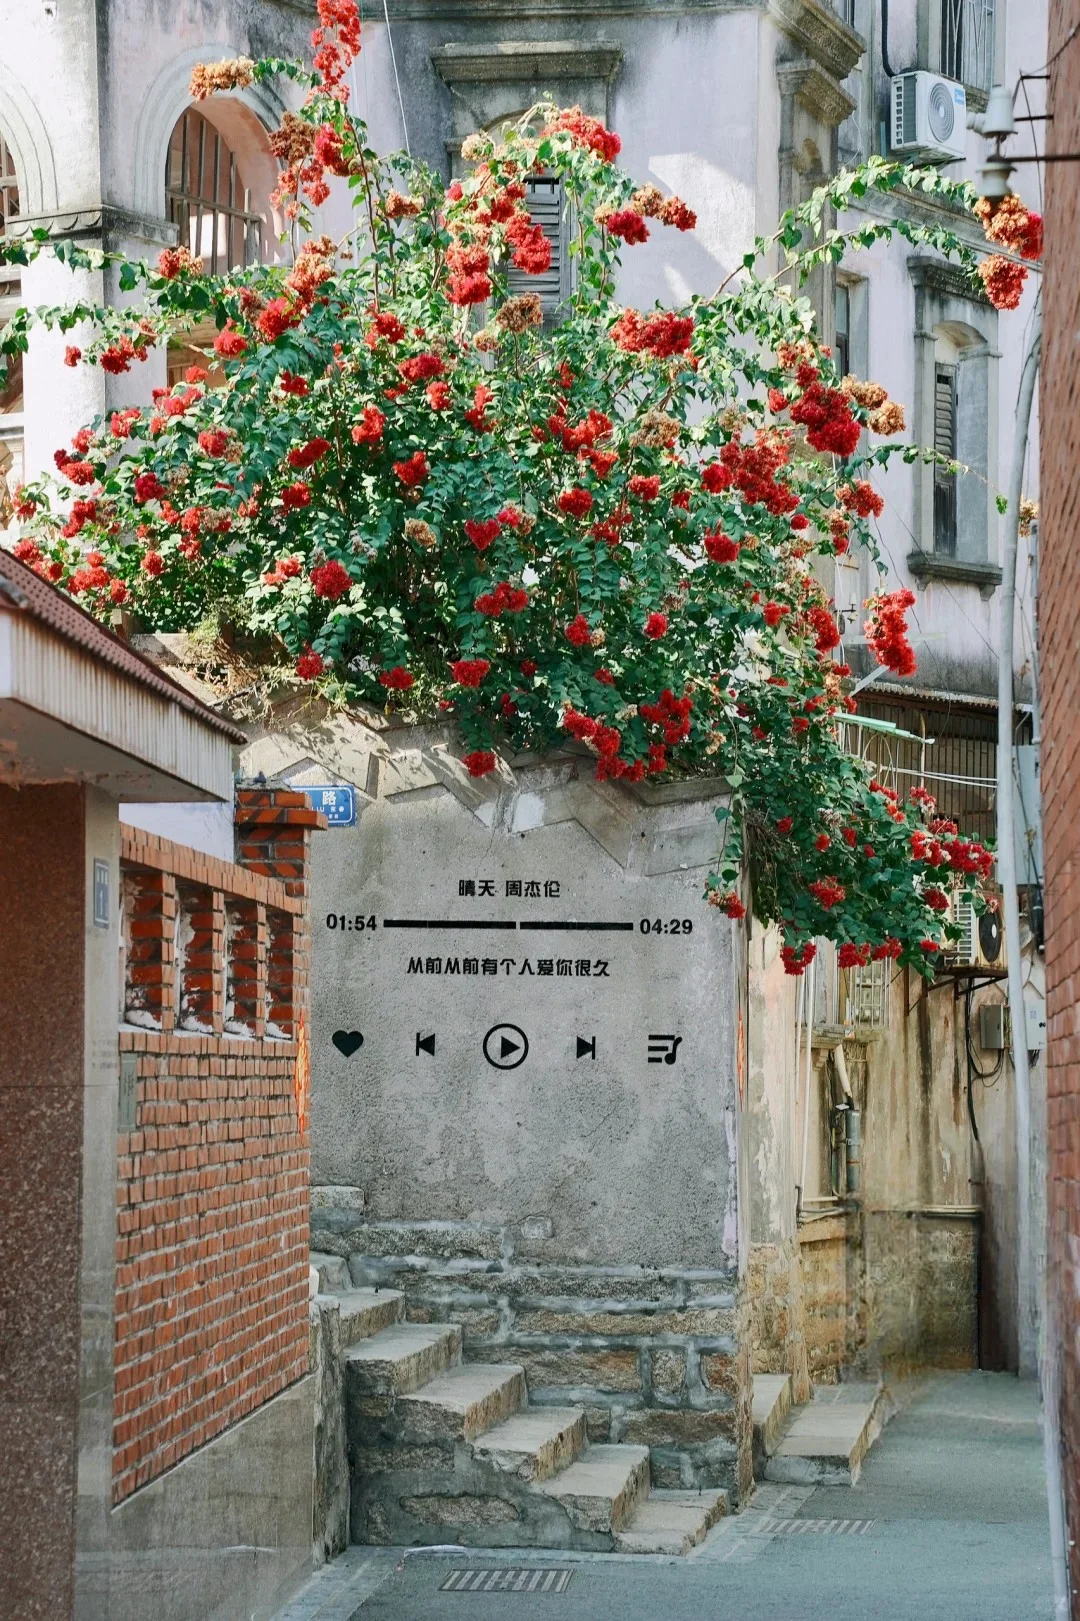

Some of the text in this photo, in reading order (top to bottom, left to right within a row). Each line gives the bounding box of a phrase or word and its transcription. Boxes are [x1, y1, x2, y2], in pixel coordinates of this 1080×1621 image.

[322, 790, 337, 806] 路
[458, 879, 561, 898] 晴天 周杰伦
[326, 913, 378, 932] 01:54
[639, 918, 693, 935] 04:29
[406, 957, 610, 978] 从前从前有个人爱你很久
